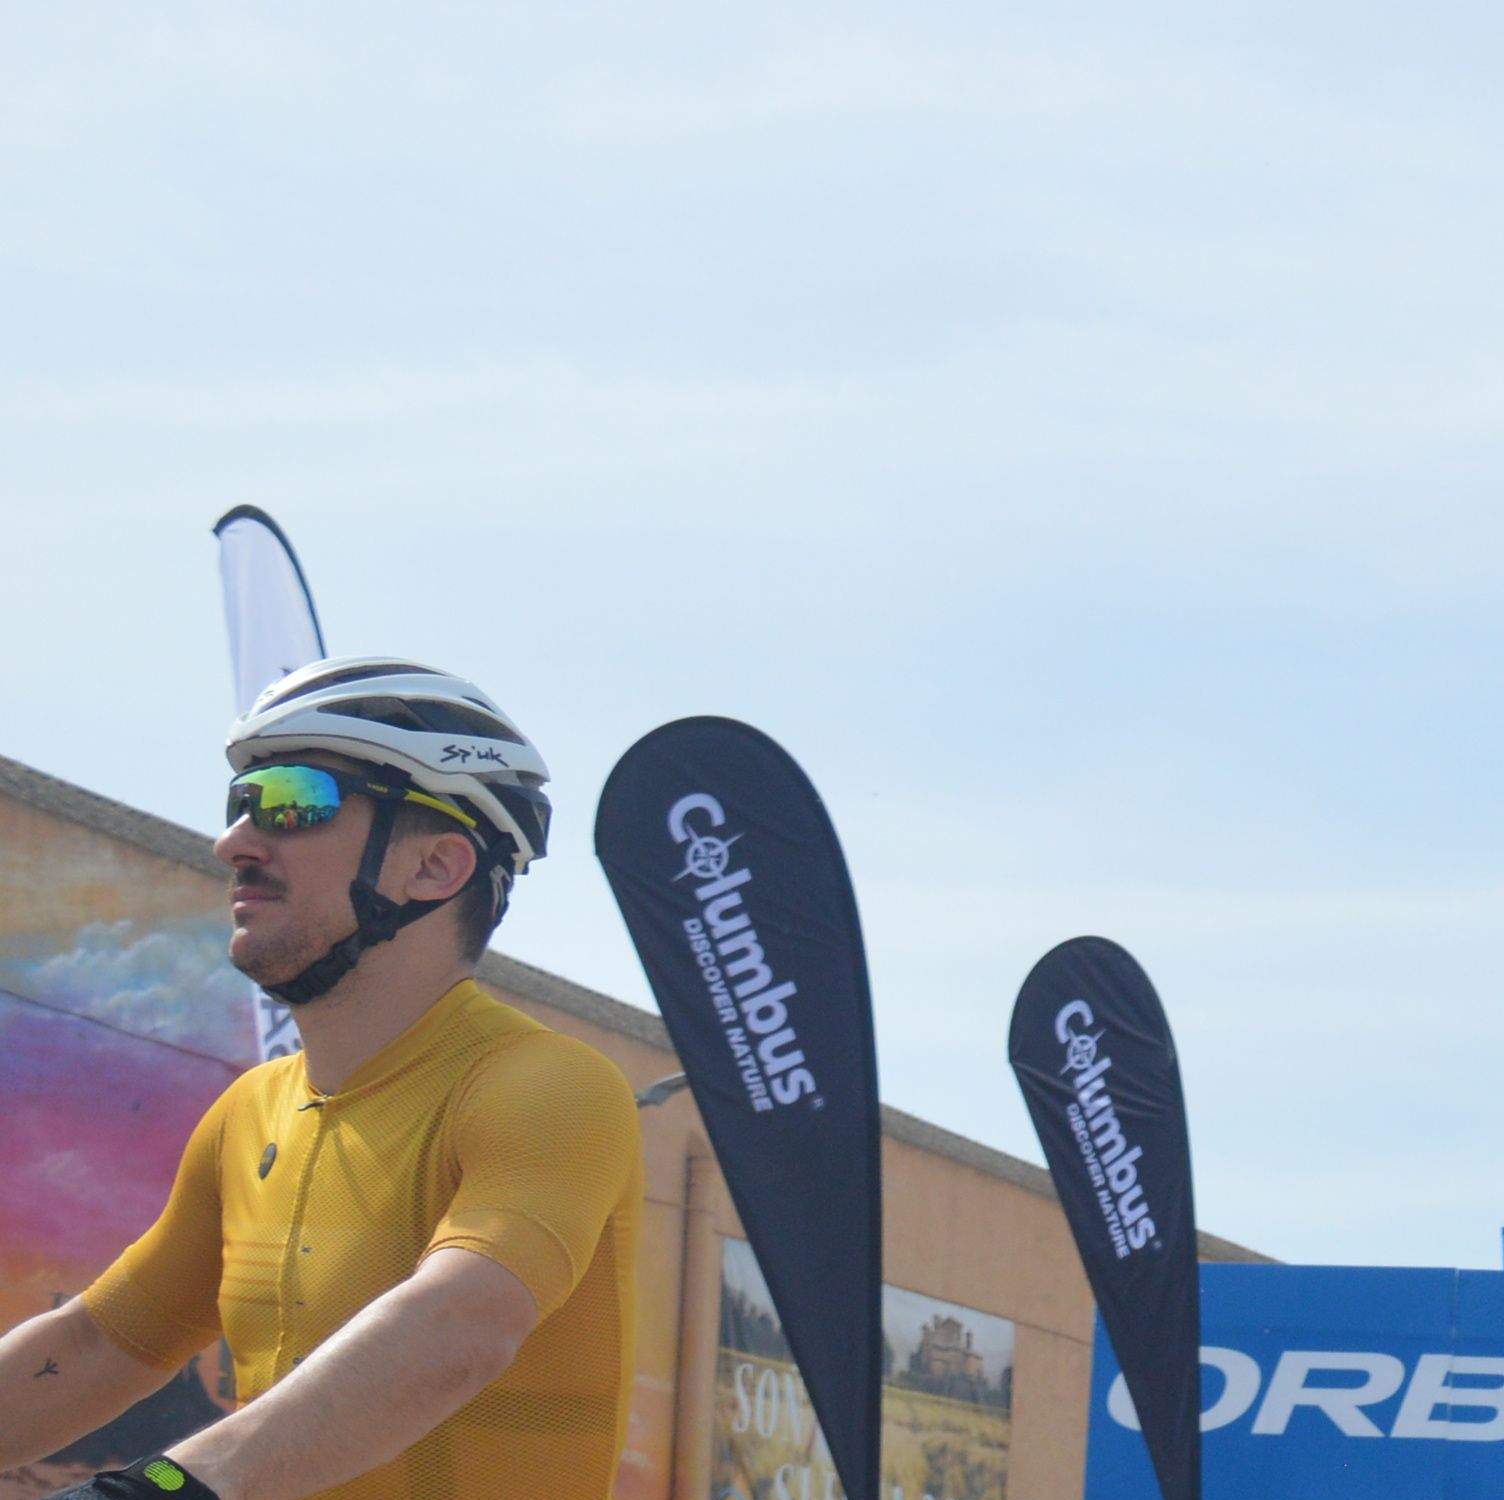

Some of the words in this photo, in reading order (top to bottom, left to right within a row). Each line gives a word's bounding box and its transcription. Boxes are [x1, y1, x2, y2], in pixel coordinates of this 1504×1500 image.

[667, 792, 817, 1106] Columbus
[682, 917, 739, 1024] DISCOVER
[725, 1026, 775, 1113] NATURE
[1055, 1000, 1156, 1250] Columbus
[1066, 1103, 1106, 1188] DISCOVER
[1096, 1188, 1131, 1260] NATURE
